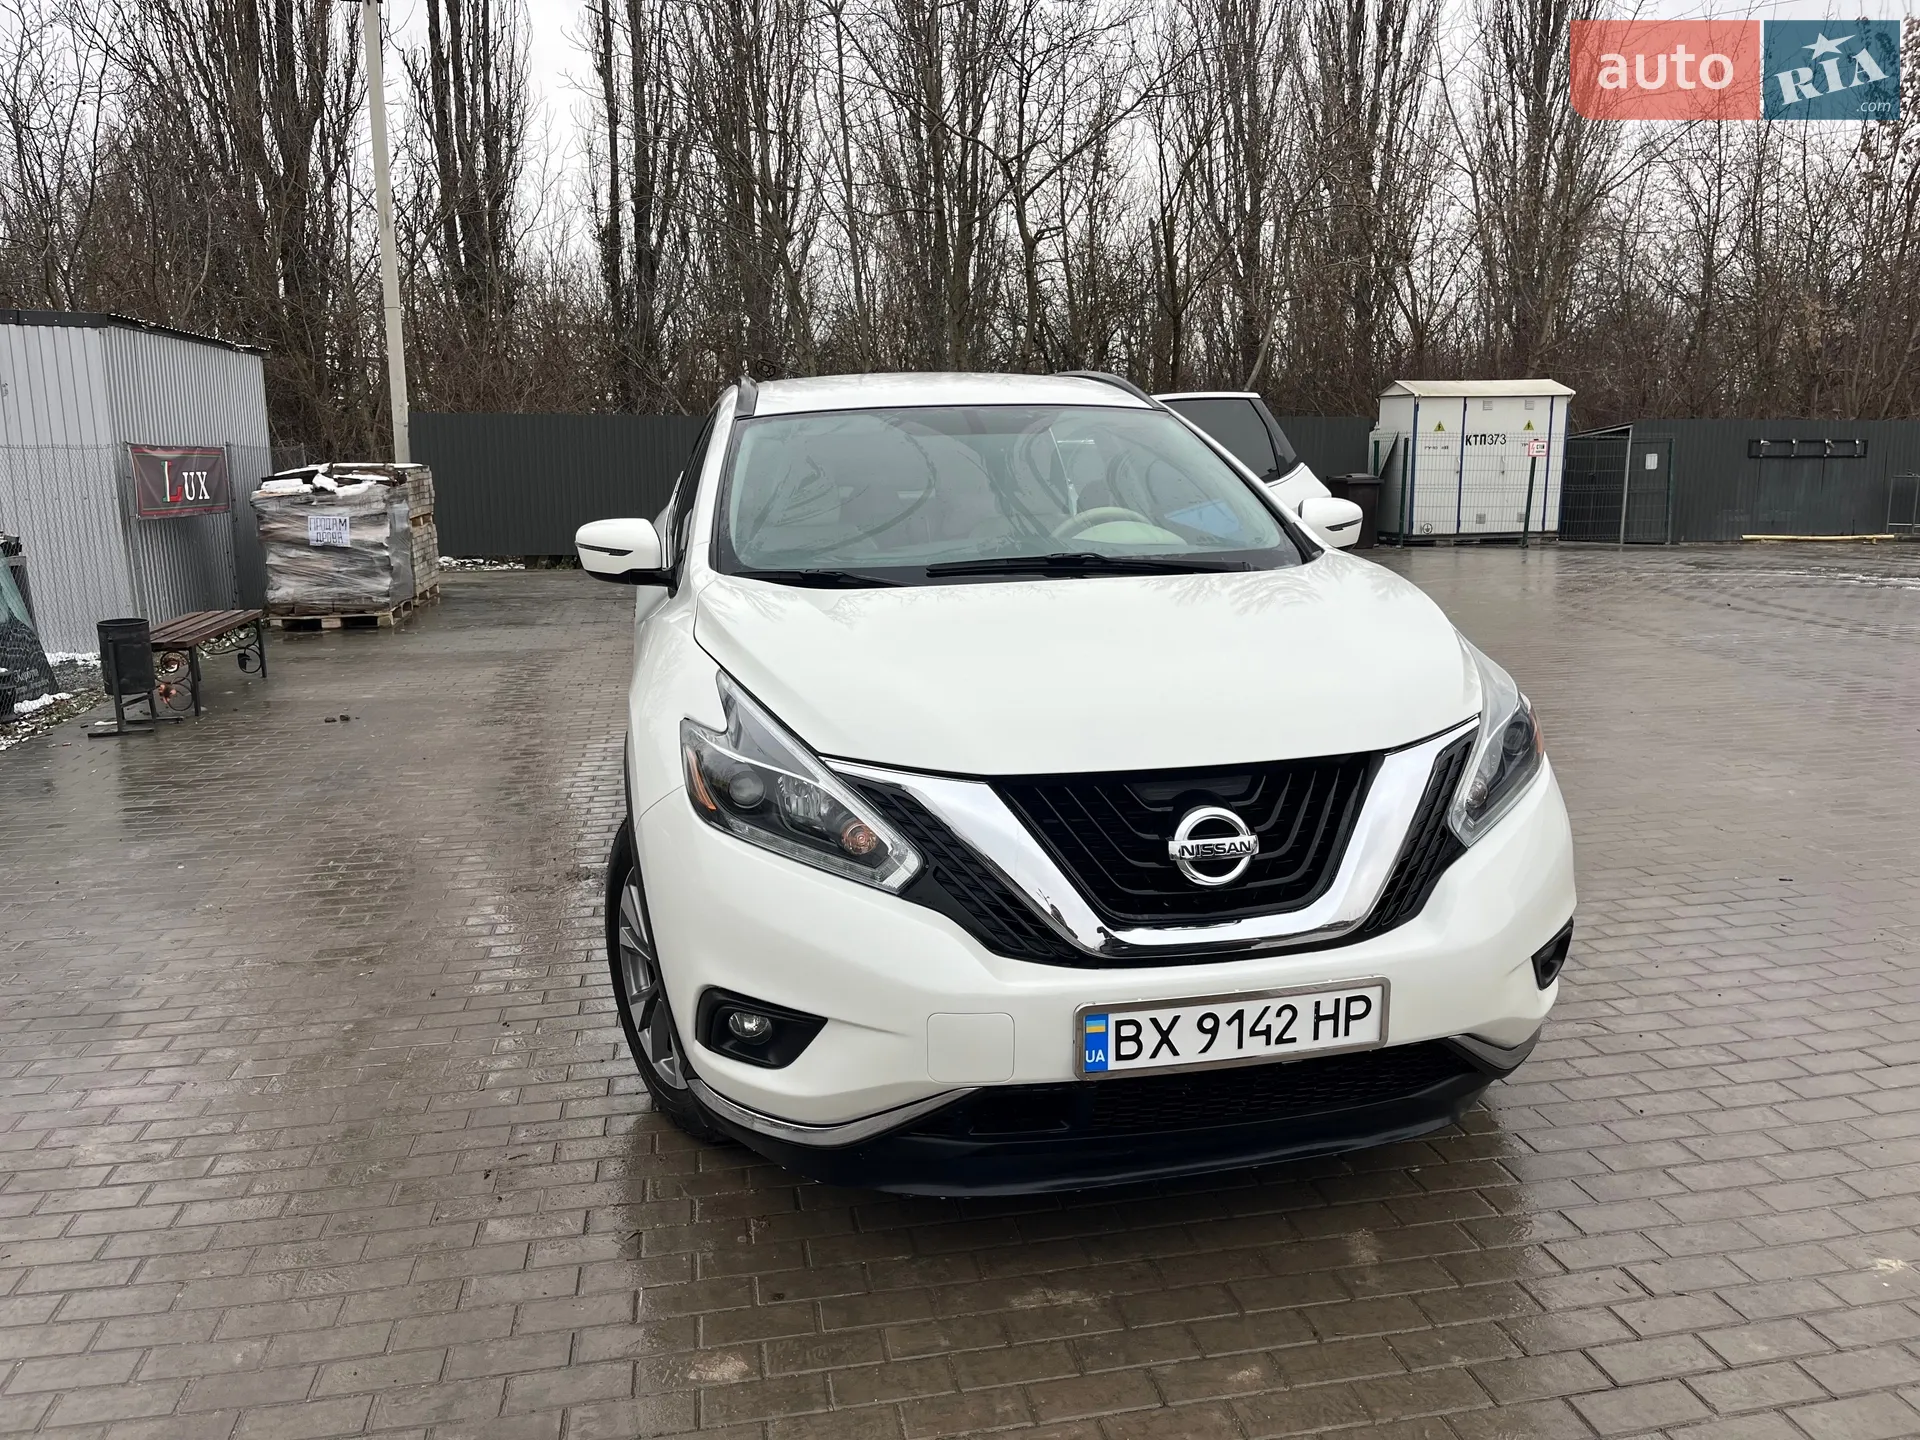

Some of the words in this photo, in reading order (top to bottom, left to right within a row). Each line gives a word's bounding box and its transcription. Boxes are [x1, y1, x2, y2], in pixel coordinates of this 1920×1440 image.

[309, 517, 347, 531] ПРОДАМ
[315, 531, 344, 544] ДРОВА
[1179, 840, 1251, 857] NISSAN
[1114, 1014, 1181, 1061] BX
[1196, 1003, 1298, 1055] 9142
[1313, 994, 1373, 1041] HP
[1085, 1049, 1106, 1063] UA
